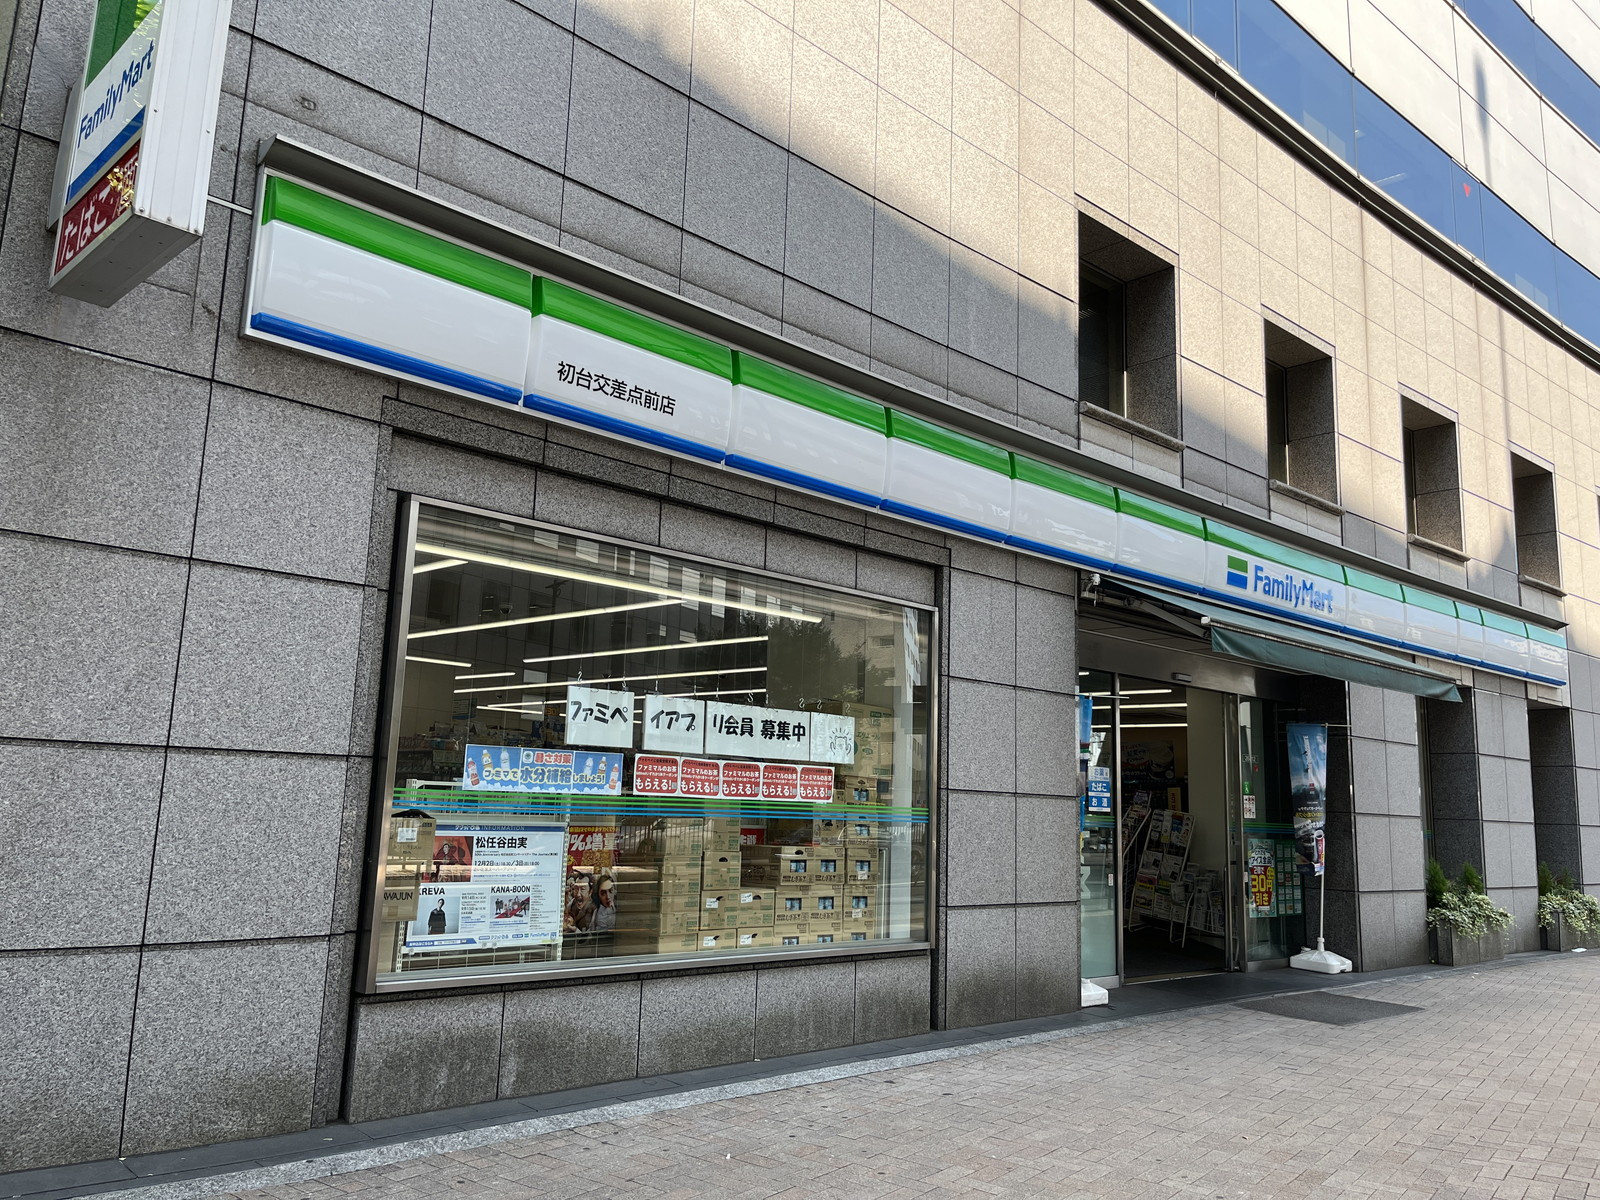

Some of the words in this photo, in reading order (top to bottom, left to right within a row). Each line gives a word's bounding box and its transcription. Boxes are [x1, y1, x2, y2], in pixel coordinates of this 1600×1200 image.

[77, 39, 154, 149] FamilyMart
[557, 361, 677, 416] 初台交差点前店
[1253, 564, 1334, 614] FamilyMart
[570, 700, 629, 725] ファミペ
[651, 709, 697, 732] イアプ
[713, 713, 754, 738] リ会員
[760, 718, 807, 742] 募集中
[533, 752, 573, 764] 暑さ対策
[637, 764, 678, 773] ファミマルのお茶
[682, 767, 719, 776] ファミマルのお茶
[763, 772, 797, 780] ファミマルのお茶
[635, 778, 672, 791] もらえる!
[680, 780, 714, 793] もらえる!
[722, 783, 755, 795] もらえる!
[762, 785, 793, 796] もらえる!
[1091, 782, 1107, 792] たばこ
[800, 787, 828, 798] もらえる!
[475, 836, 528, 849] 松任谷由実
[490, 885, 531, 894] KANA-BOON
[1255, 892, 1269, 906] 引き
